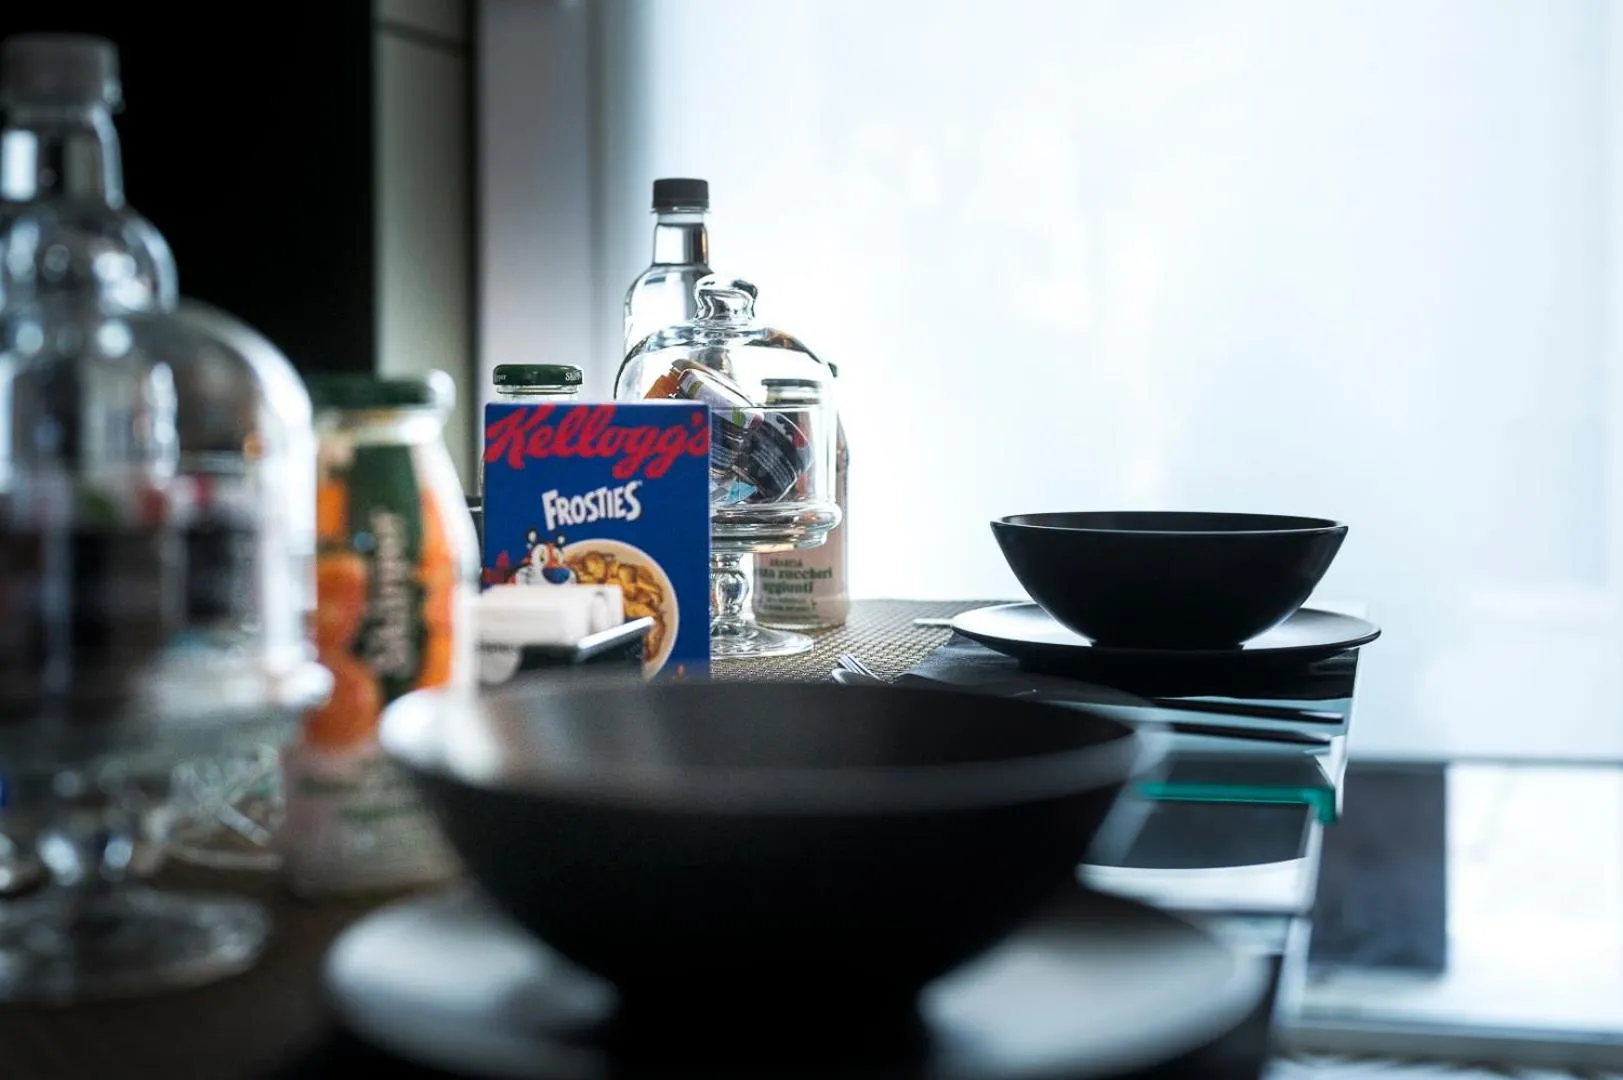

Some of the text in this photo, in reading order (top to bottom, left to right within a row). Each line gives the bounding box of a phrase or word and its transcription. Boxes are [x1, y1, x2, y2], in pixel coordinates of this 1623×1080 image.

[483, 403, 710, 479] Kellogg's
[541, 481, 642, 531] FROSTIES
[778, 566, 833, 579] zuccheri
